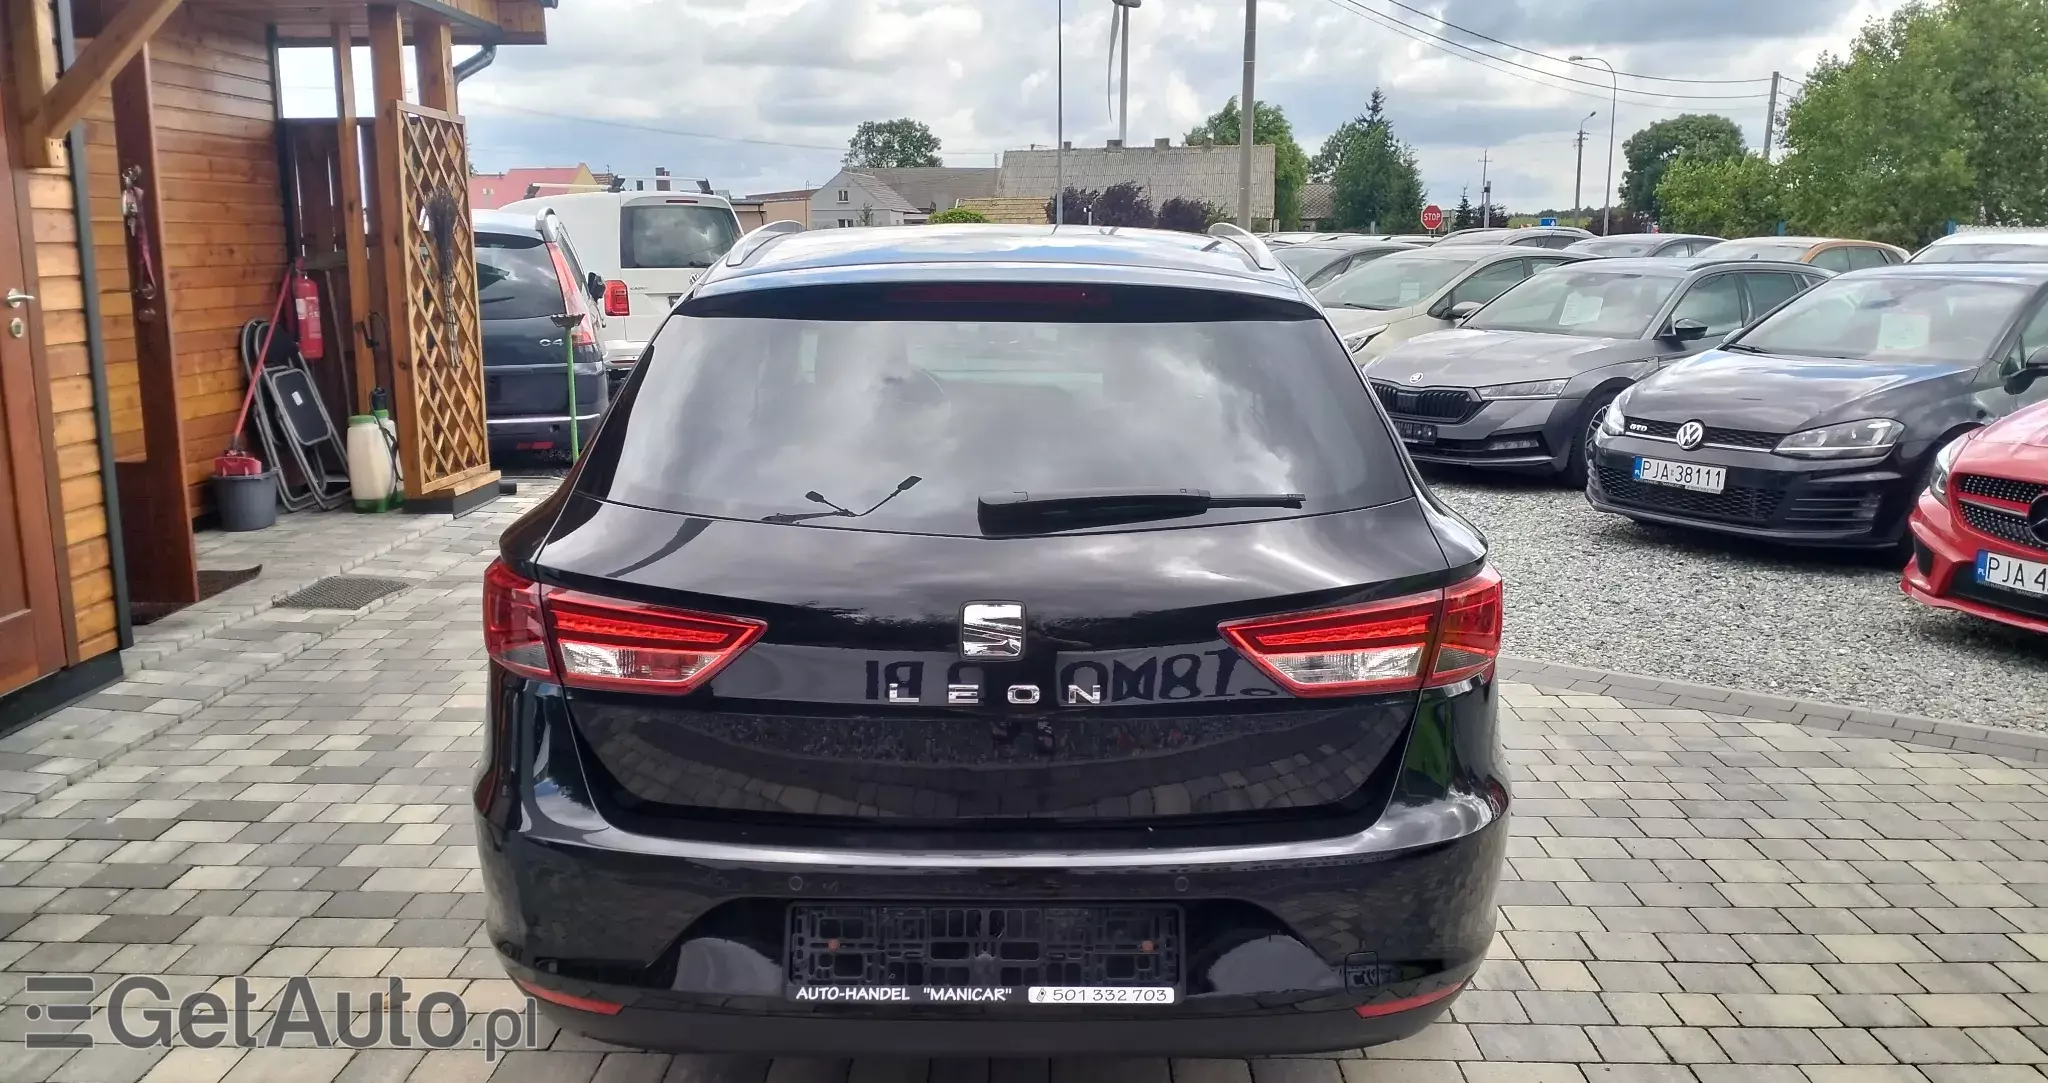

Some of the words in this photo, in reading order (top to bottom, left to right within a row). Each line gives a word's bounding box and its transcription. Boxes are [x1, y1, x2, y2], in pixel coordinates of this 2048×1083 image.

[1423, 212, 1441, 221] STOP
[539, 338, 564, 347] C4
[1629, 423, 1648, 432] GTD
[1641, 460, 1669, 481] PJA
[1674, 465, 1721, 488] 38111
[1977, 567, 1985, 576] PL
[1987, 556, 2025, 587] PJA
[2033, 567, 2048, 592] 4
[888, 683, 1101, 704] LEON
[795, 986, 910, 1001] AUTO-HANDEL
[923, 987, 1012, 1002] "MANICAR"
[1052, 989, 1086, 1002] 501
[1092, 989, 1128, 1002] 332
[1132, 989, 1168, 1002] 703
